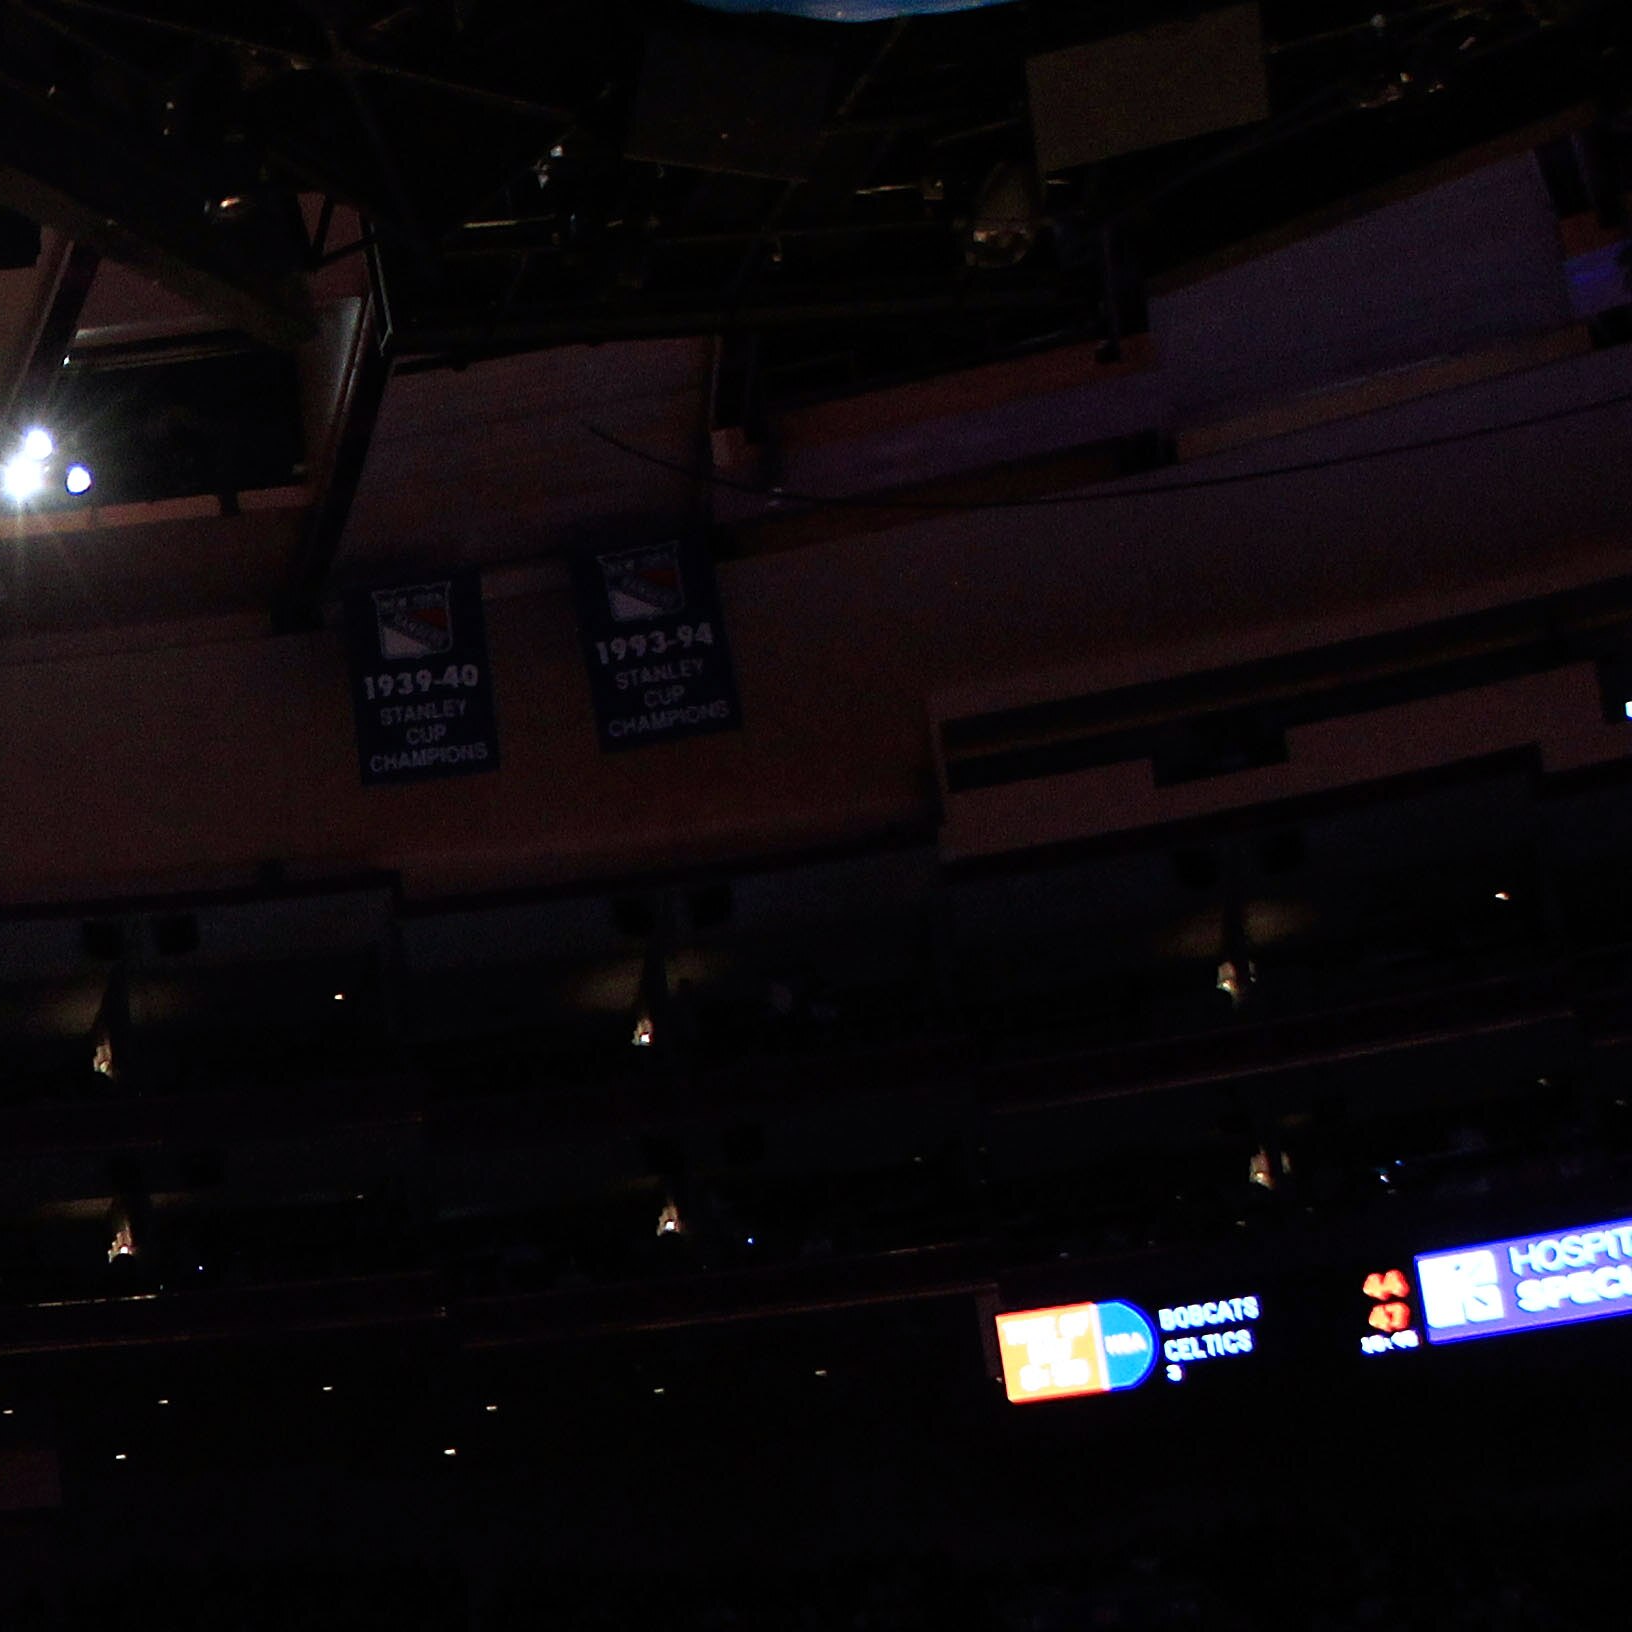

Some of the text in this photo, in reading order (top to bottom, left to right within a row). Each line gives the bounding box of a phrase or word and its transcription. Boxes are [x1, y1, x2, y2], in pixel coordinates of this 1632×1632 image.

[595, 621, 715, 666] 1993-94
[363, 663, 480, 701] 1939-40
[614, 656, 705, 690] STANLEY
[379, 698, 467, 726] STANLEY
[643, 684, 686, 709] CUP
[405, 723, 447, 745] CUP
[607, 699, 730, 739] CHAMPIONS
[369, 741, 489, 773] CHAMPIONS
[1158, 1296, 1261, 1331] BOBCATS
[1163, 1328, 1253, 1362] CELTICS
